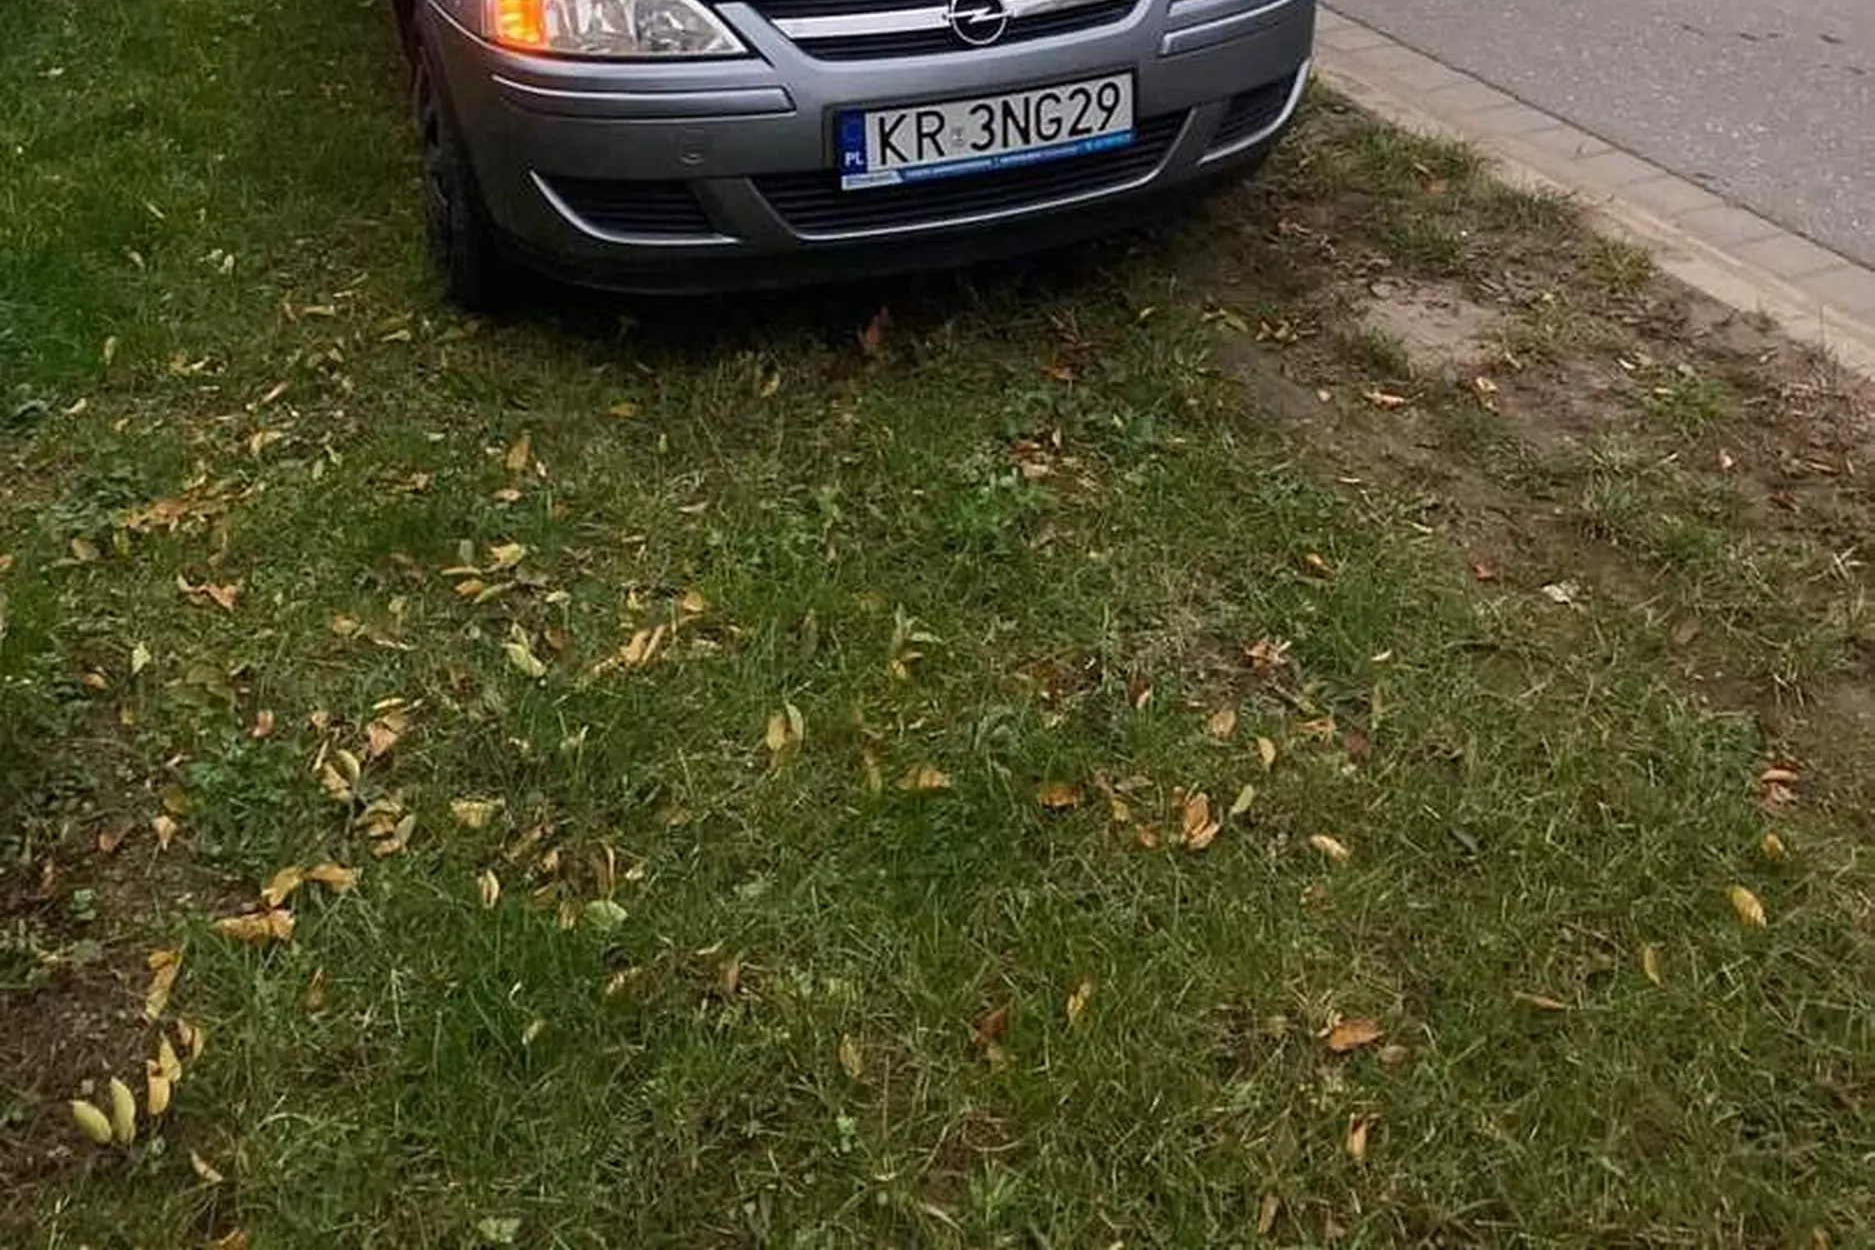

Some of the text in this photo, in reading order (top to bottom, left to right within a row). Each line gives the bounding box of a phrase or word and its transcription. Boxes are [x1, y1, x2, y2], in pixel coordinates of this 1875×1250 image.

[877, 109, 947, 166] KR
[967, 81, 1122, 152] 3NG29
[844, 151, 865, 167] PL
